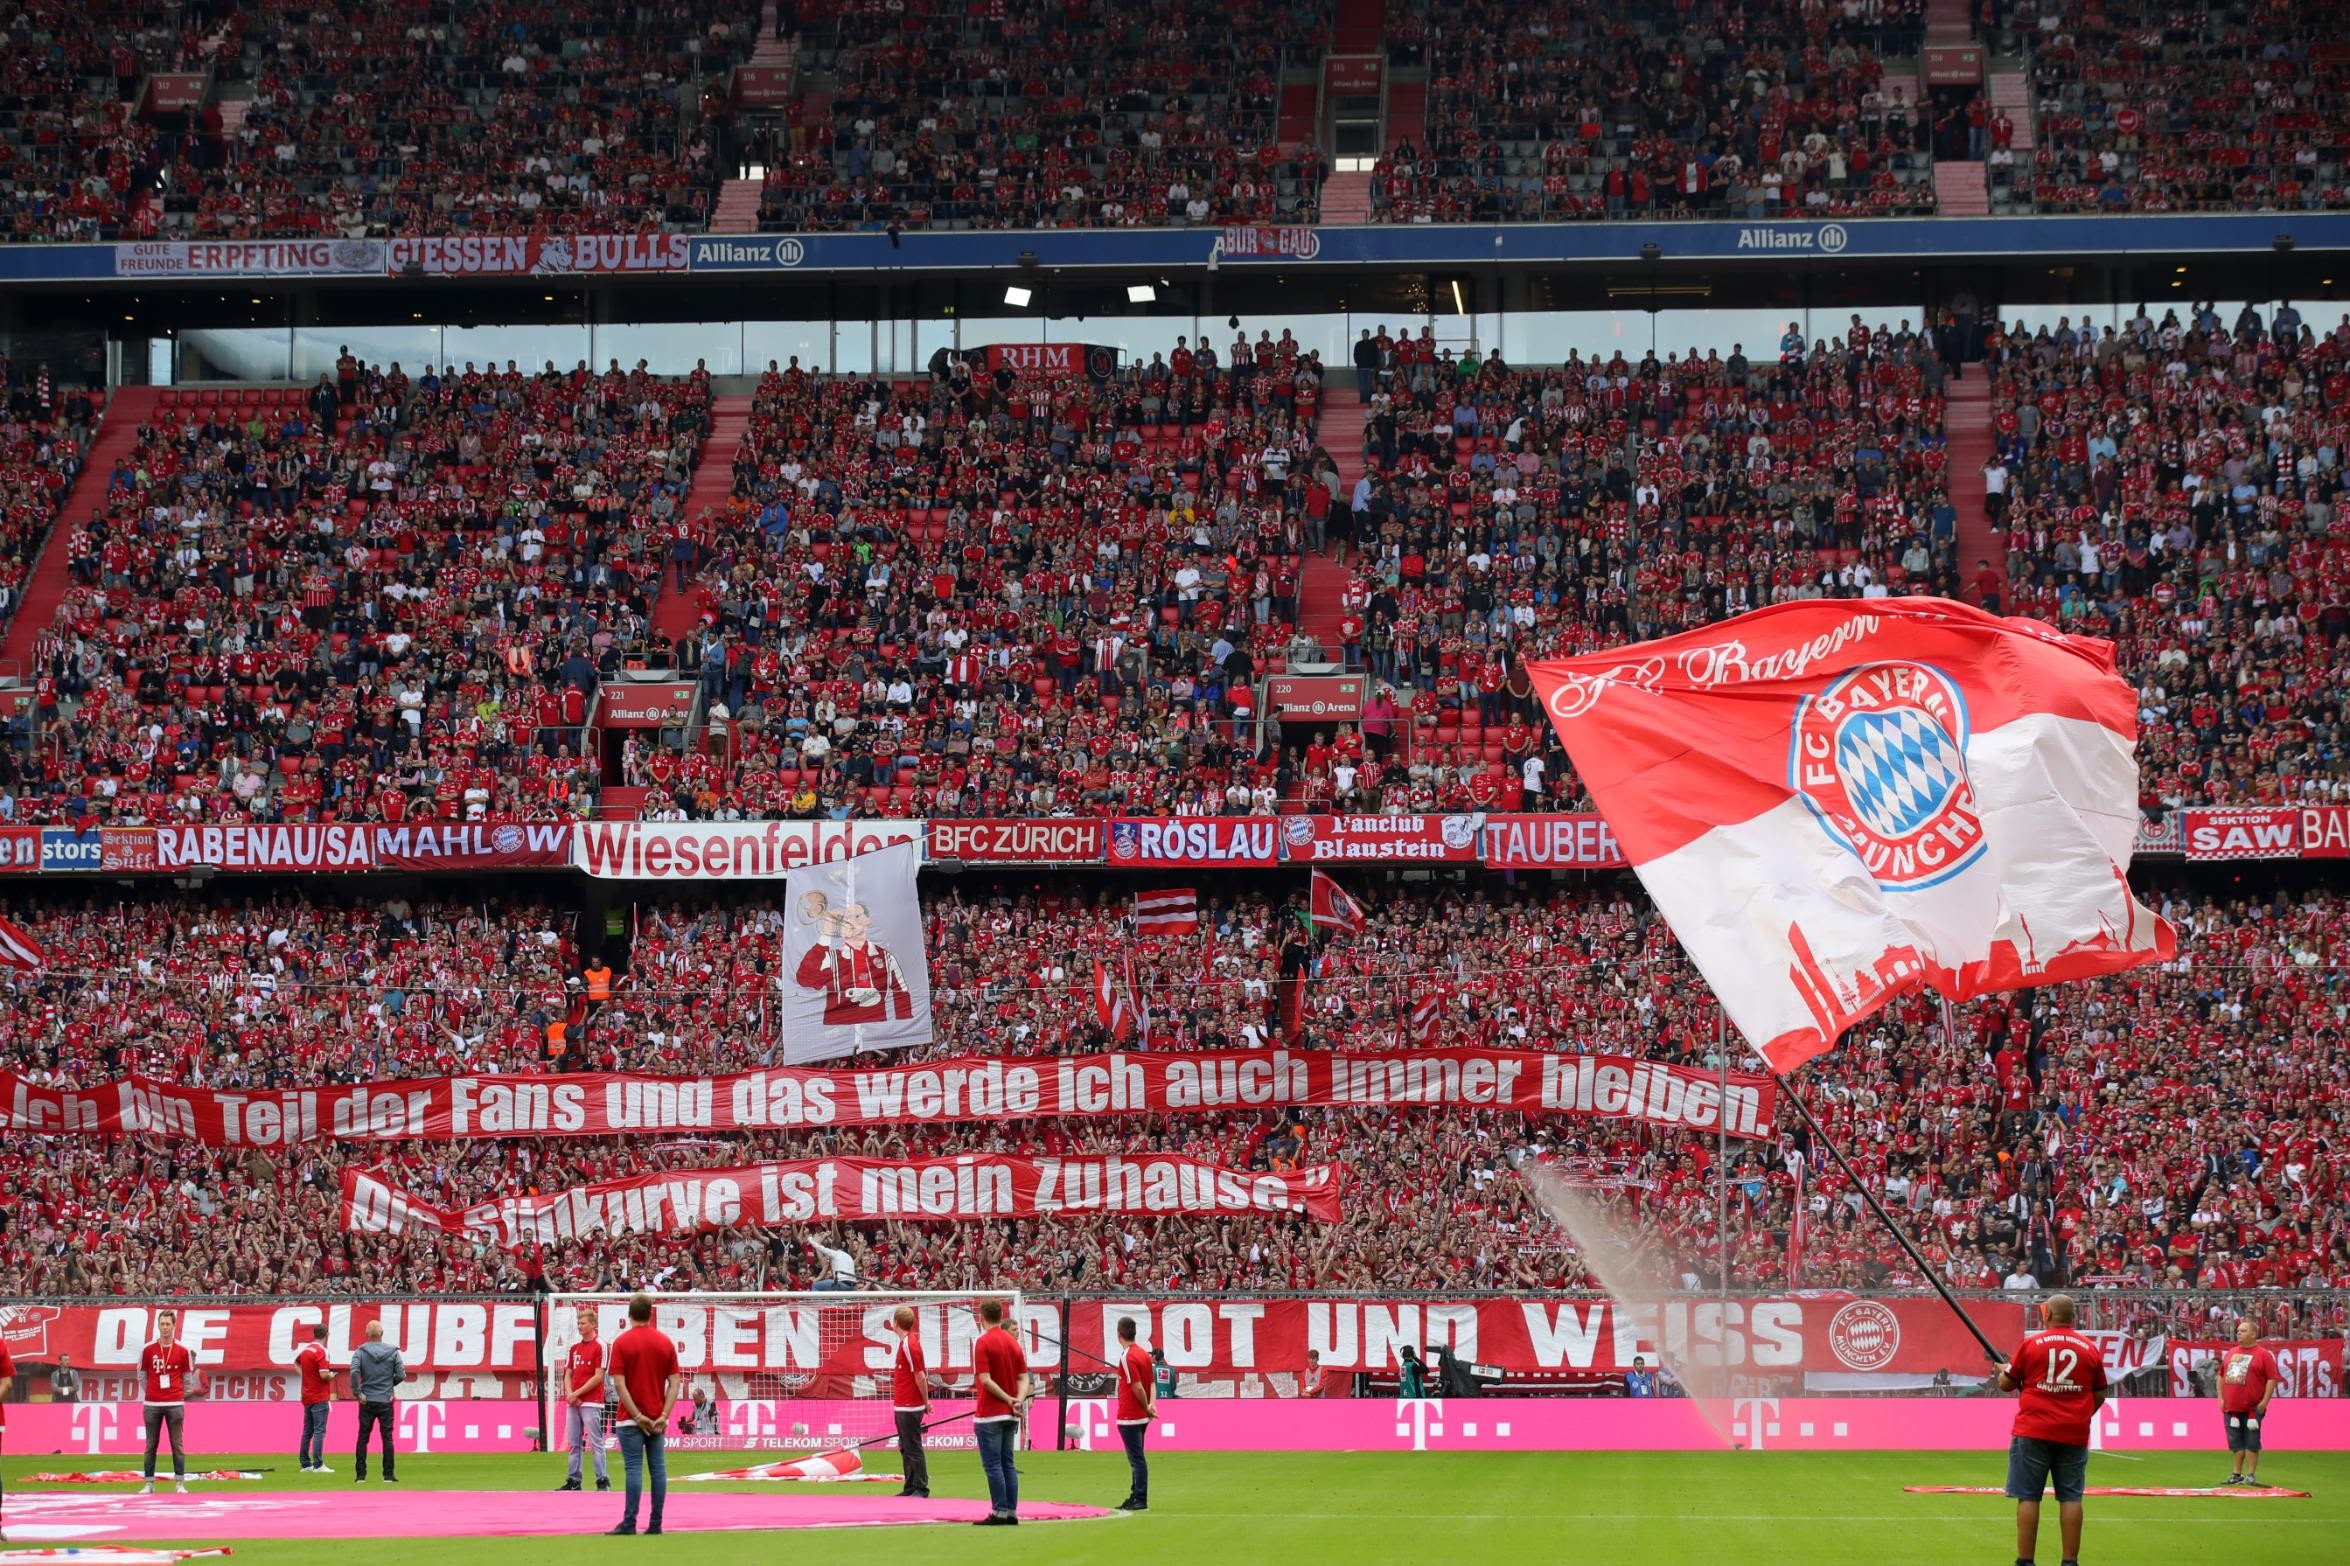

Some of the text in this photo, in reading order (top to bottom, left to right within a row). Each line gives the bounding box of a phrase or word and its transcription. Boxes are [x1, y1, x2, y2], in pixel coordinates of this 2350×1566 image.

[133, 243, 171, 256] GUTE
[1737, 228, 1814, 249] Allianz
[120, 258, 184, 271] FREUNDE
[187, 243, 330, 269] ERPFTING
[388, 233, 690, 273] GIESSEN BULLS
[696, 241, 771, 263] Allianz
[999, 346, 1071, 370] RHM
[610, 691, 625, 700] 221
[1275, 684, 1293, 694] 220
[1814, 665, 1950, 723] BAYERN
[610, 709, 645, 719] Allianz
[1277, 703, 1356, 712] llianz Arena
[1804, 731, 1837, 787] FC
[2208, 815, 2272, 826] SEKTION
[156, 826, 370, 867] RABENAU/SA
[934, 824, 988, 853] BFC
[993, 822, 1095, 854] ZÜRICH
[1140, 819, 1274, 860] RÖSLAU
[1310, 838, 1446, 860] Blaustein
[2192, 824, 2293, 851] SAW
[117, 1080, 197, 1139] bin
[213, 1090, 319, 1147] Teil
[333, 1086, 433, 1138] der
[450, 1077, 586, 1134] Fans
[605, 1071, 713, 1128] und
[732, 1070, 837, 1125] das
[854, 1060, 1040, 1119] werde
[1057, 1053, 1146, 1112] ich
[1164, 1049, 1309, 1107] auch
[1330, 1054, 1523, 1105] immer
[1541, 1053, 1770, 1137] bleiben.
[761, 1162, 840, 1222] ist
[860, 1156, 1014, 1214] mein
[1854, 1306, 1893, 1333] BAYERN
[94, 1306, 231, 1366] DIE
[1102, 1302, 1265, 1368] ROT
[1307, 1302, 1478, 1368] UND
[1521, 1302, 1804, 1368] WEISS
[2046, 1347, 2078, 1384] 12
[81, 1375, 140, 1401] RED
[682, 1436, 723, 1448] SPORT
[762, 1436, 822, 1448] TELEKOM
